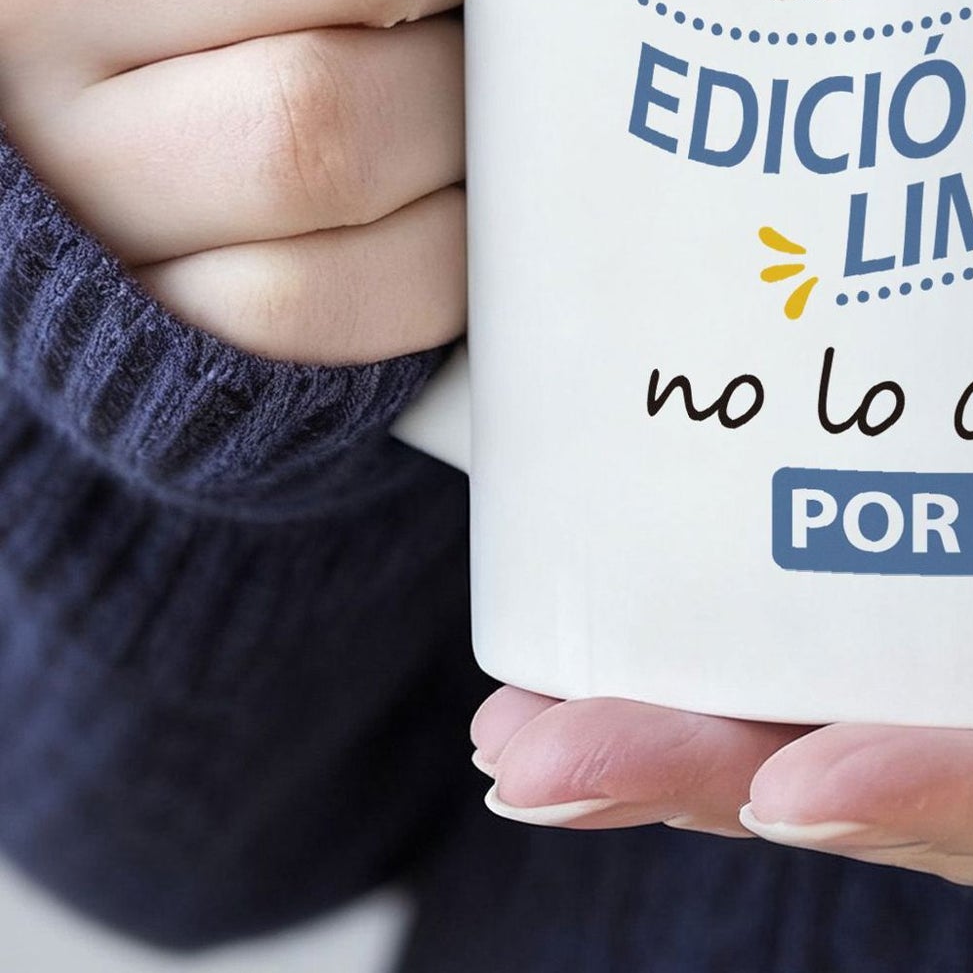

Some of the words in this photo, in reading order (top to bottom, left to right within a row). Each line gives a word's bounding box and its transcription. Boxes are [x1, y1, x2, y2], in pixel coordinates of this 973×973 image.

[646, 368, 765, 430] no
[817, 346, 906, 438] lo
[791, 488, 961, 554] POR
